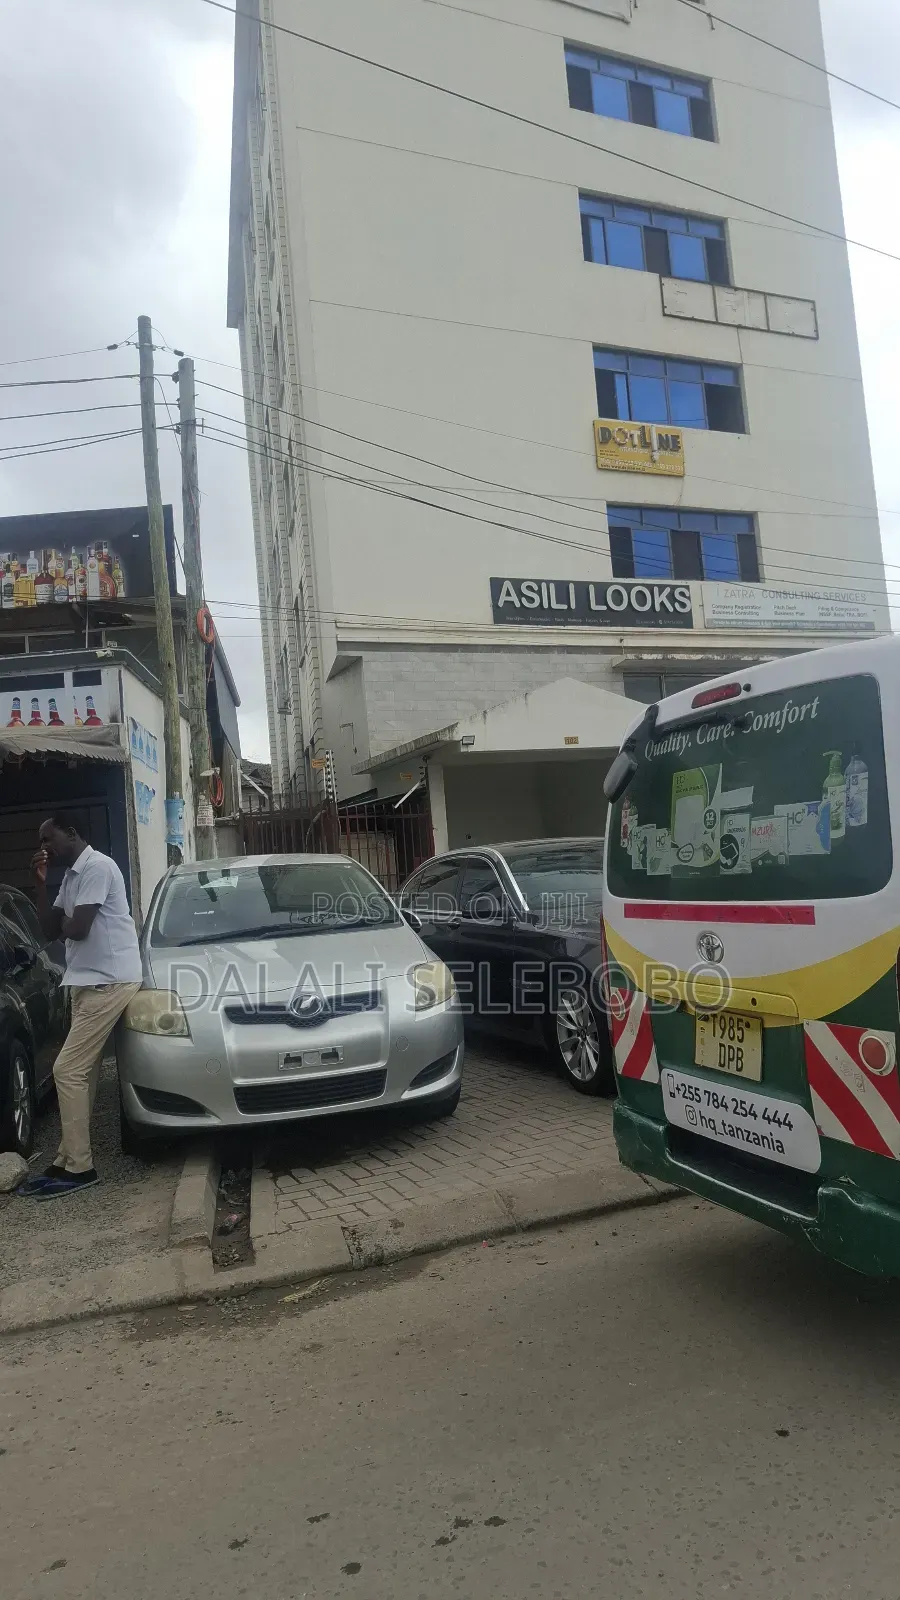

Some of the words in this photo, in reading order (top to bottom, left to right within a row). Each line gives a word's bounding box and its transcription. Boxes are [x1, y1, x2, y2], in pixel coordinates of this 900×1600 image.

[498, 580, 576, 610] ASILI
[588, 583, 693, 613] LOOKS
[711, 603, 734, 611] Company
[723, 588, 756, 600] ZATRA
[761, 589, 821, 601] CONSULTING
[822, 591, 867, 602] SERVICES
[644, 731, 692, 762] Quality.
[696, 721, 735, 746] Care.
[742, 696, 820, 734] Comfort
[705, 811, 715, 821] 12
[718, 1042, 744, 1073] DPB
[675, 1082, 701, 1103] +255
[704, 1089, 729, 1112] 784
[731, 1097, 758, 1121] 254
[761, 1107, 794, 1132] 444
[699, 1110, 786, 1155] hq_tanzania
